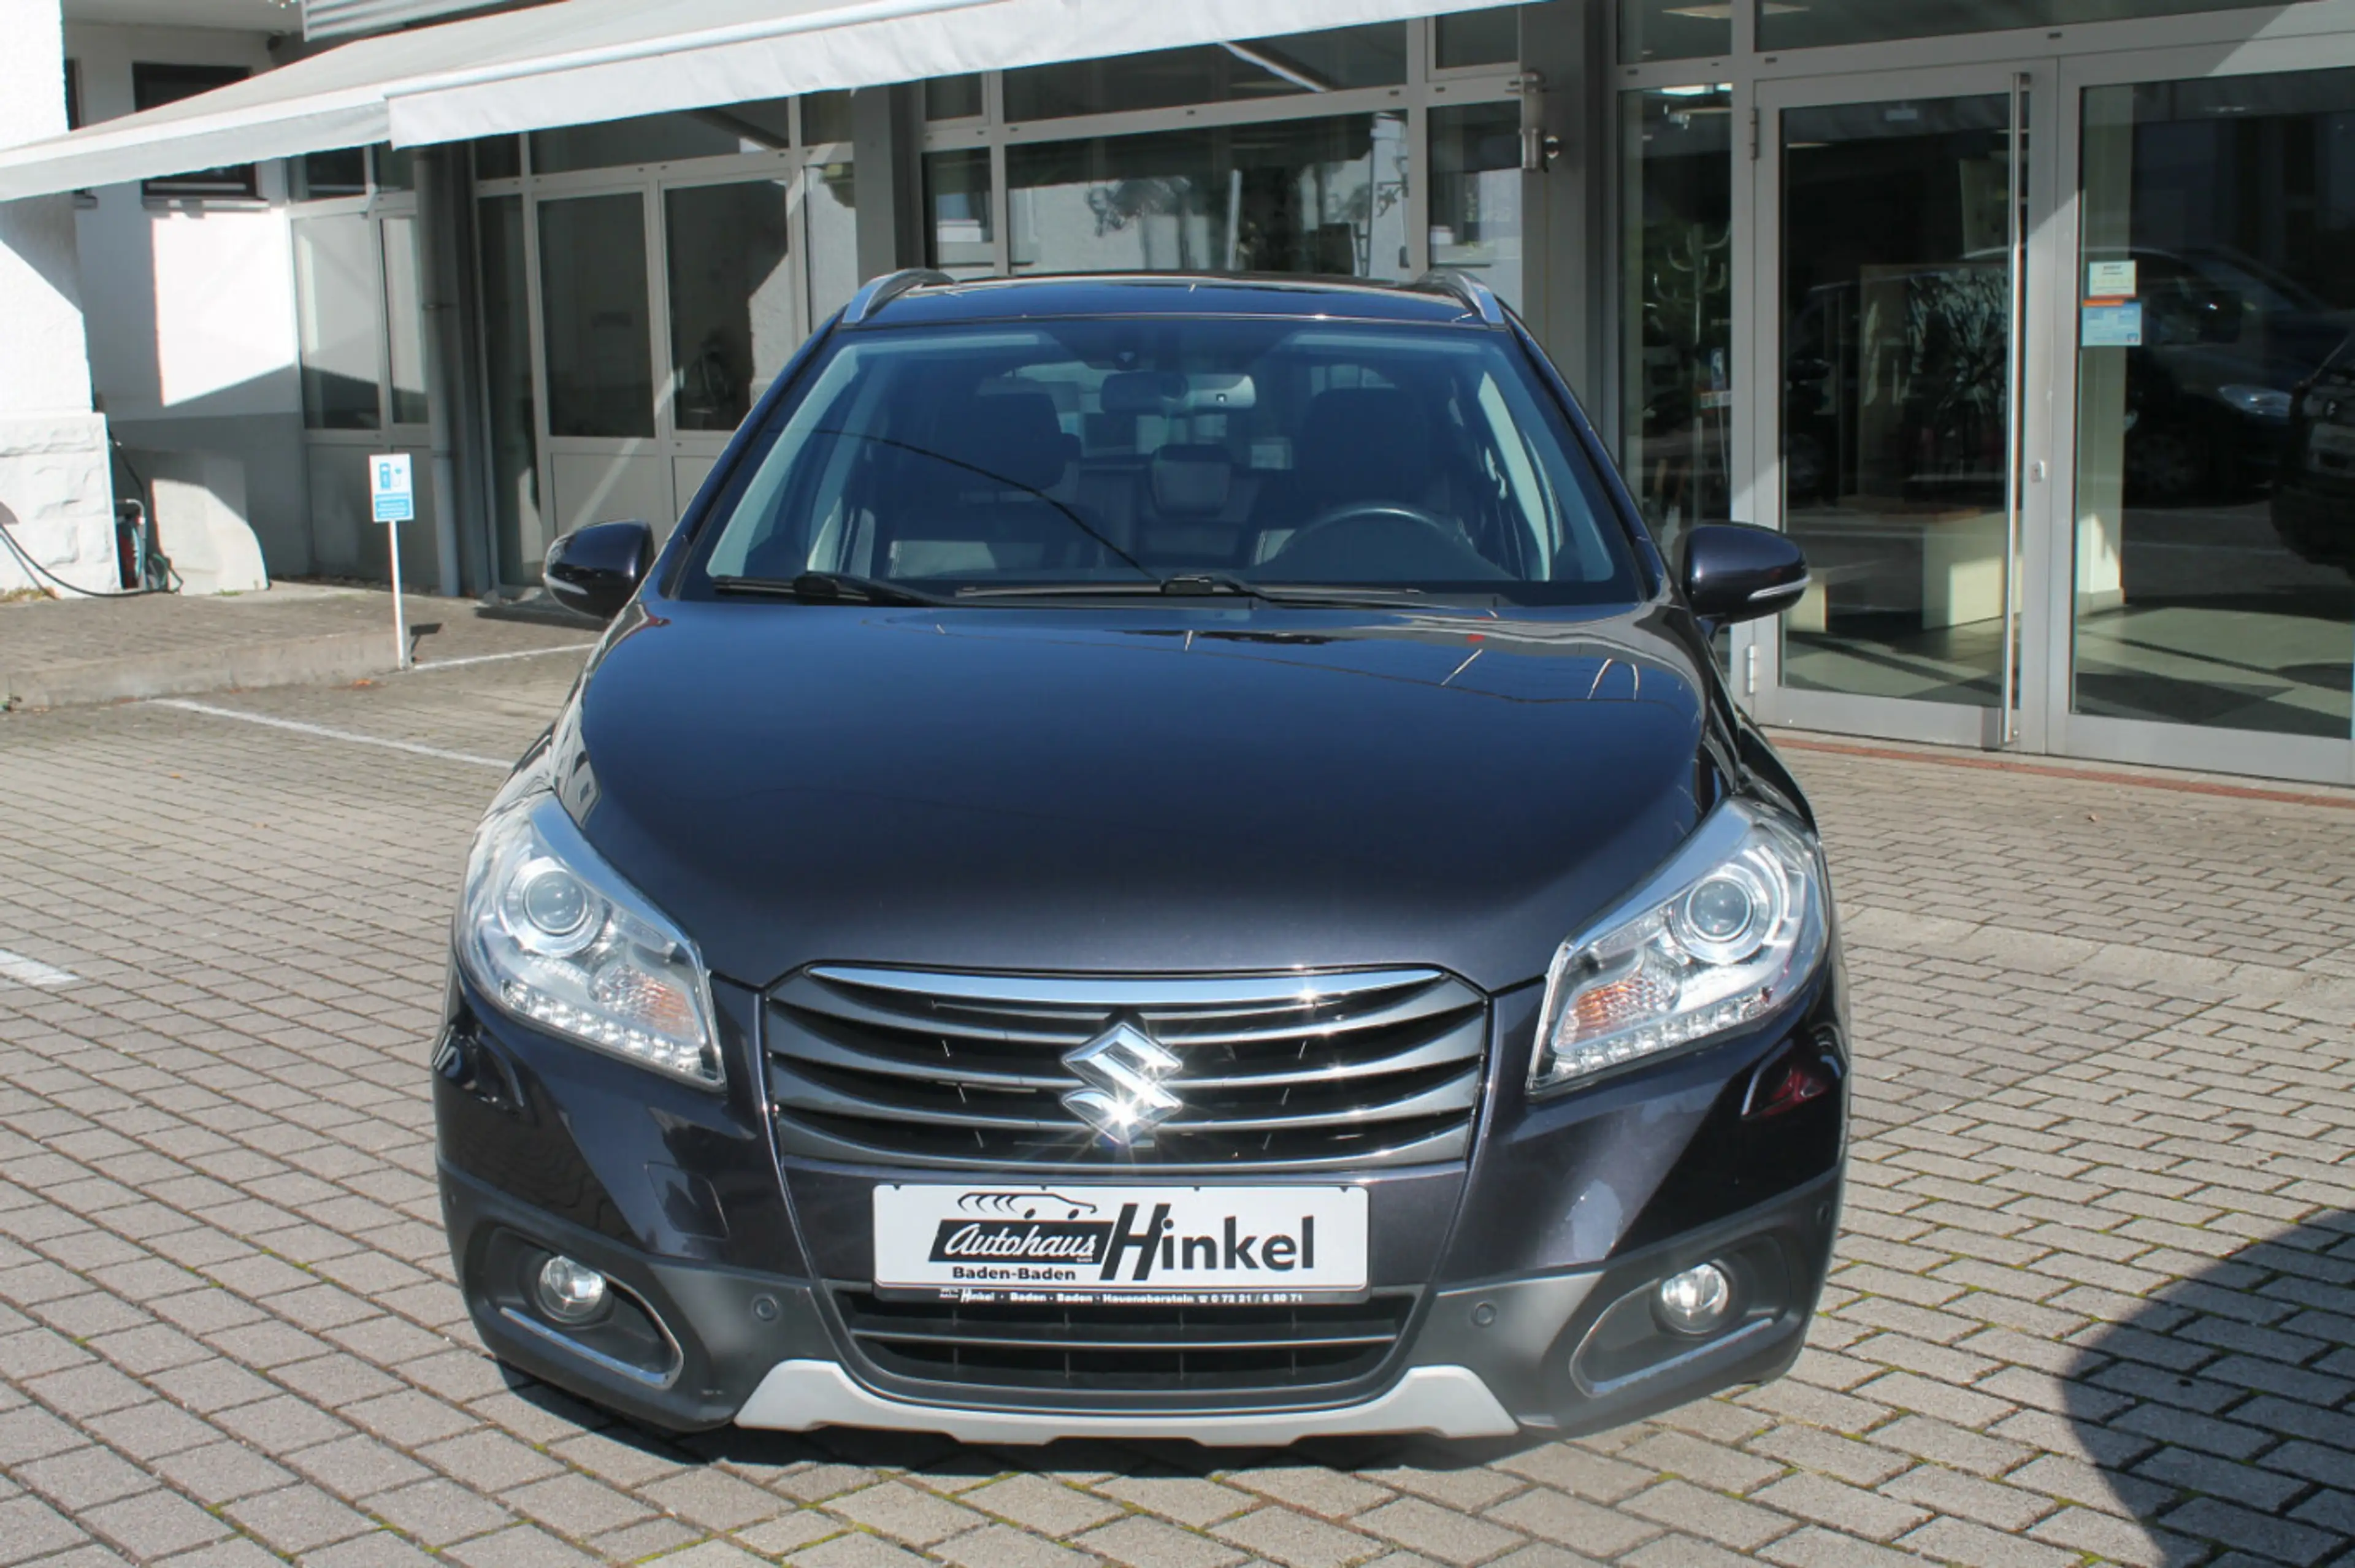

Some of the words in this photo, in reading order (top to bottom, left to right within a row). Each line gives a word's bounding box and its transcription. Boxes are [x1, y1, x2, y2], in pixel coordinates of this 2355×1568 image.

[944, 1223, 1097, 1256] Autohaus
[1099, 1203, 1314, 1281] Hinkel
[952, 1266, 1076, 1280] Baden-Baden
